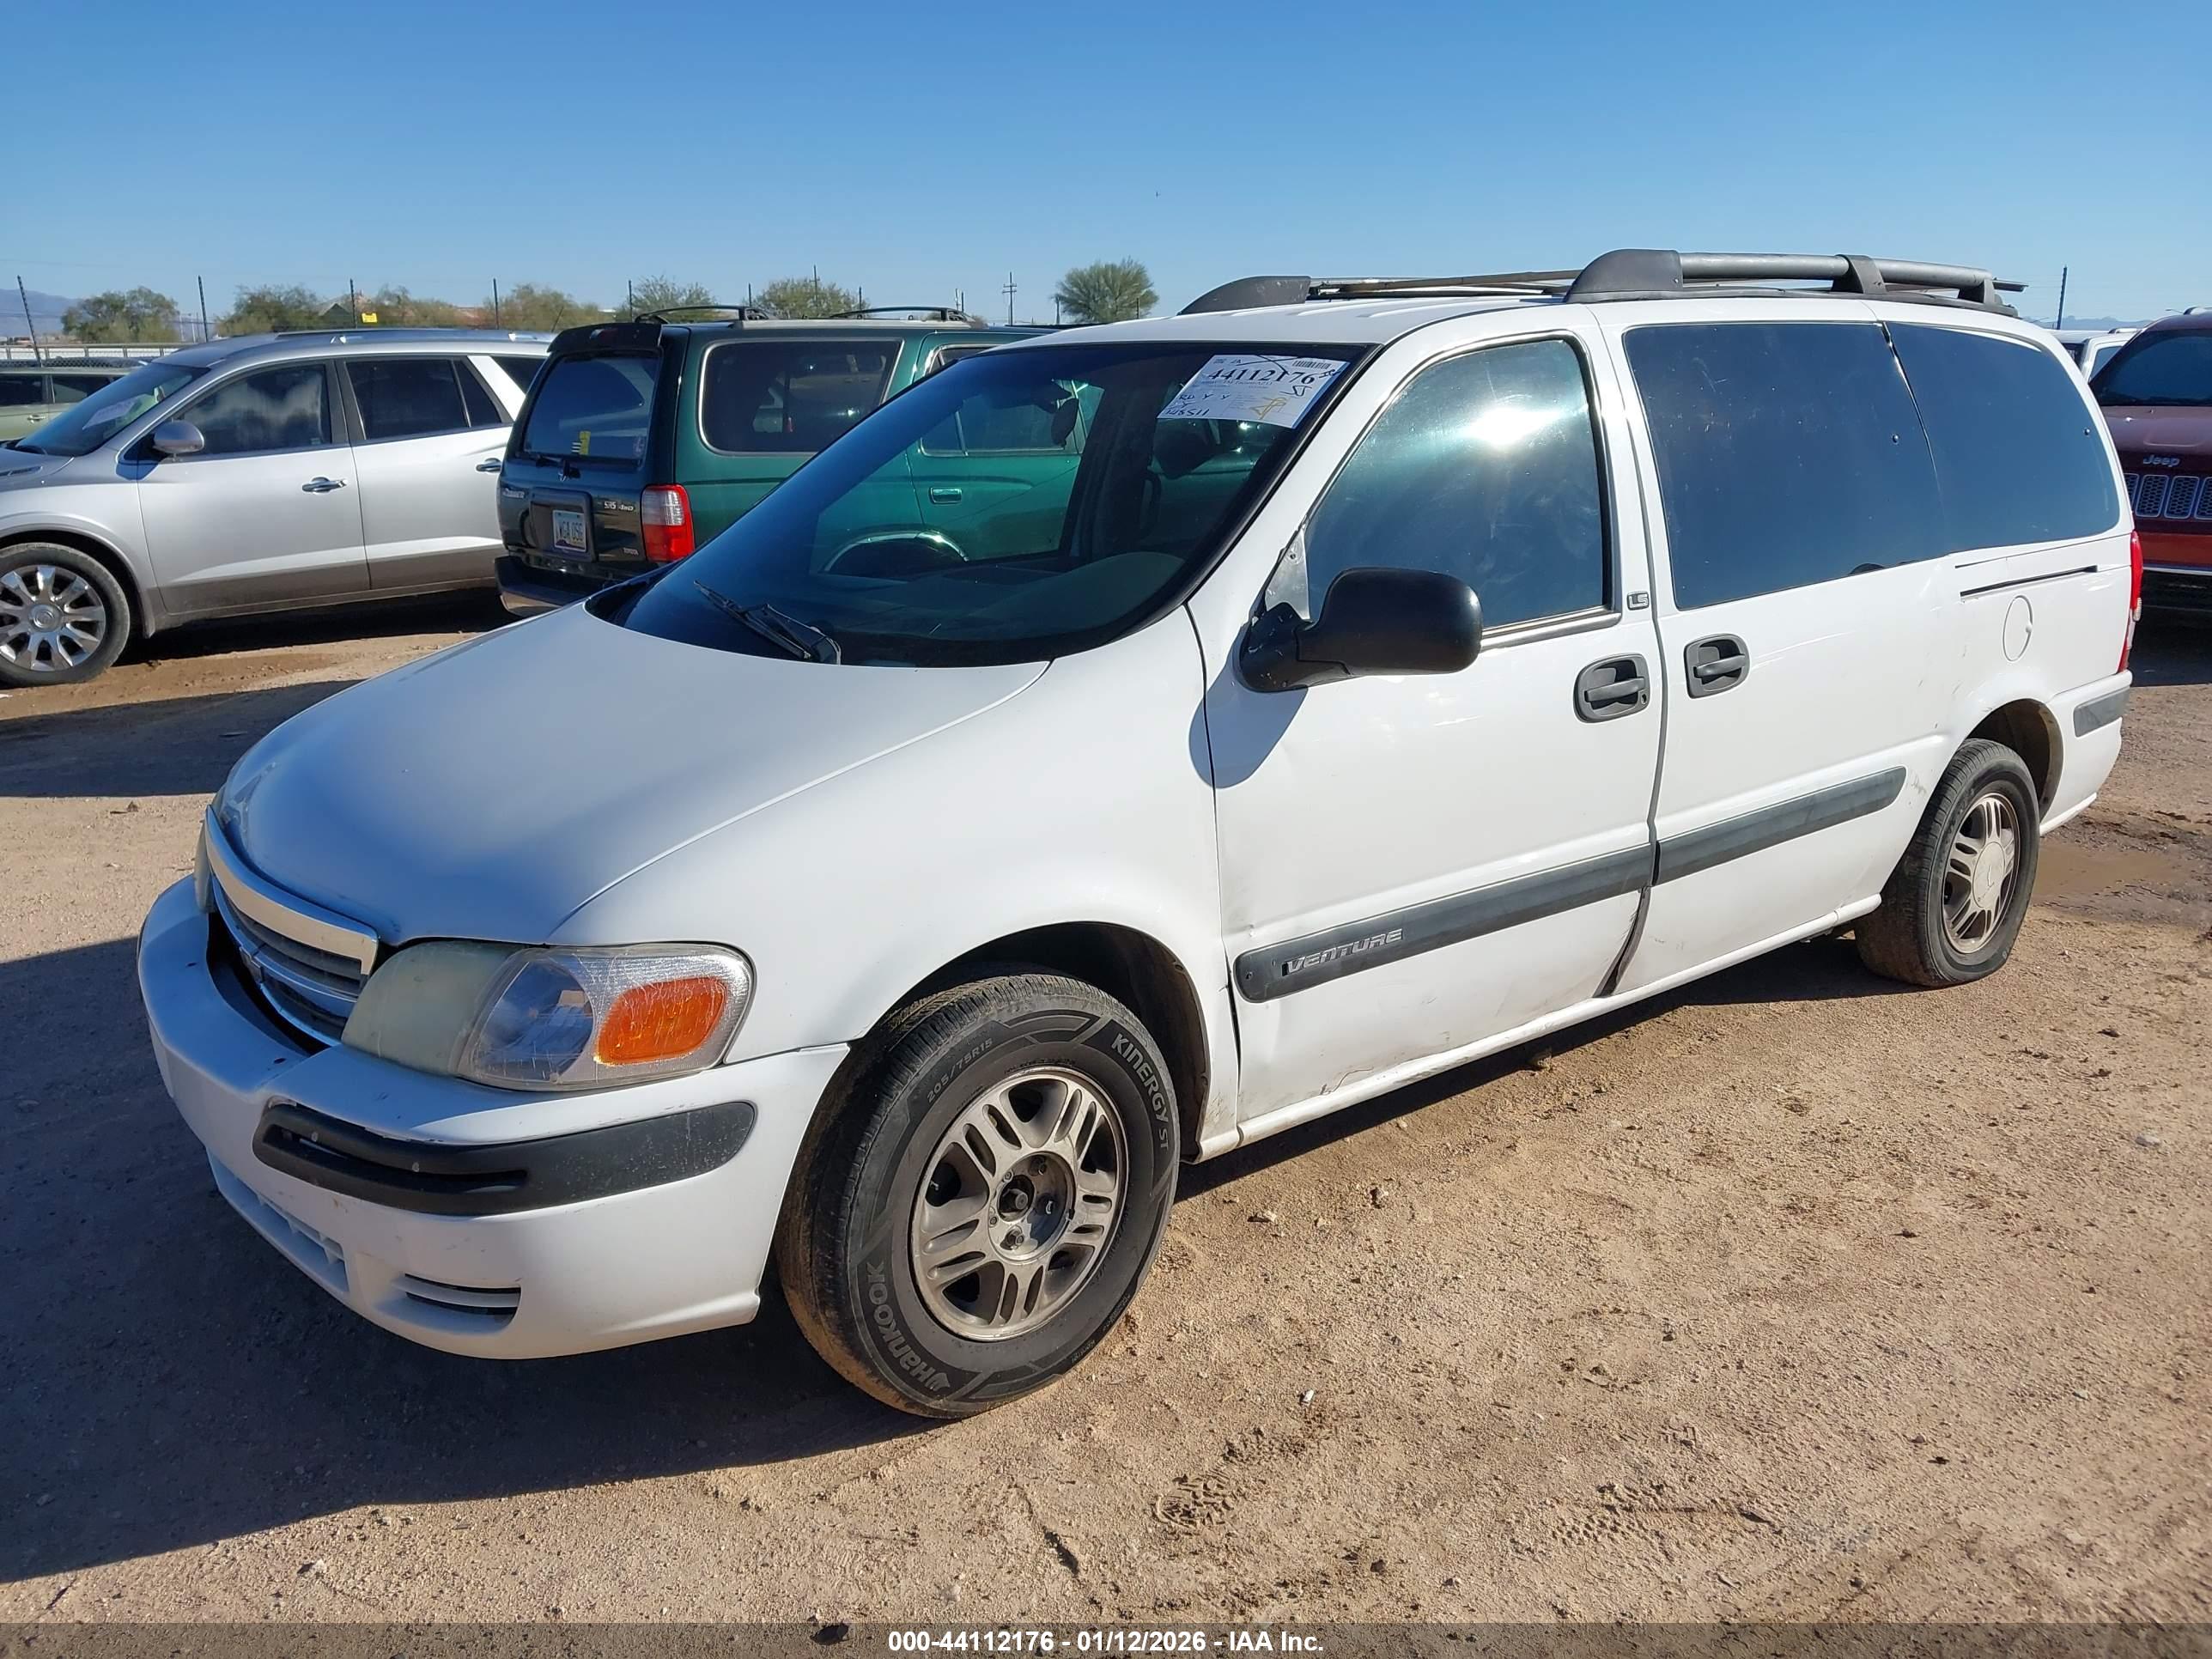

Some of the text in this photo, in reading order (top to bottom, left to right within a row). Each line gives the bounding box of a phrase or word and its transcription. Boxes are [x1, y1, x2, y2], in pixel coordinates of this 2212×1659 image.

[1207, 368, 1317, 385] 44112176
[2142, 454, 2180, 468] Jeep
[1628, 593, 1649, 609] LS
[1286, 928, 1403, 974] VENTURE
[927, 1037, 994, 1103] 205/75R15
[1111, 1033, 1169, 1151] KINERGY ST
